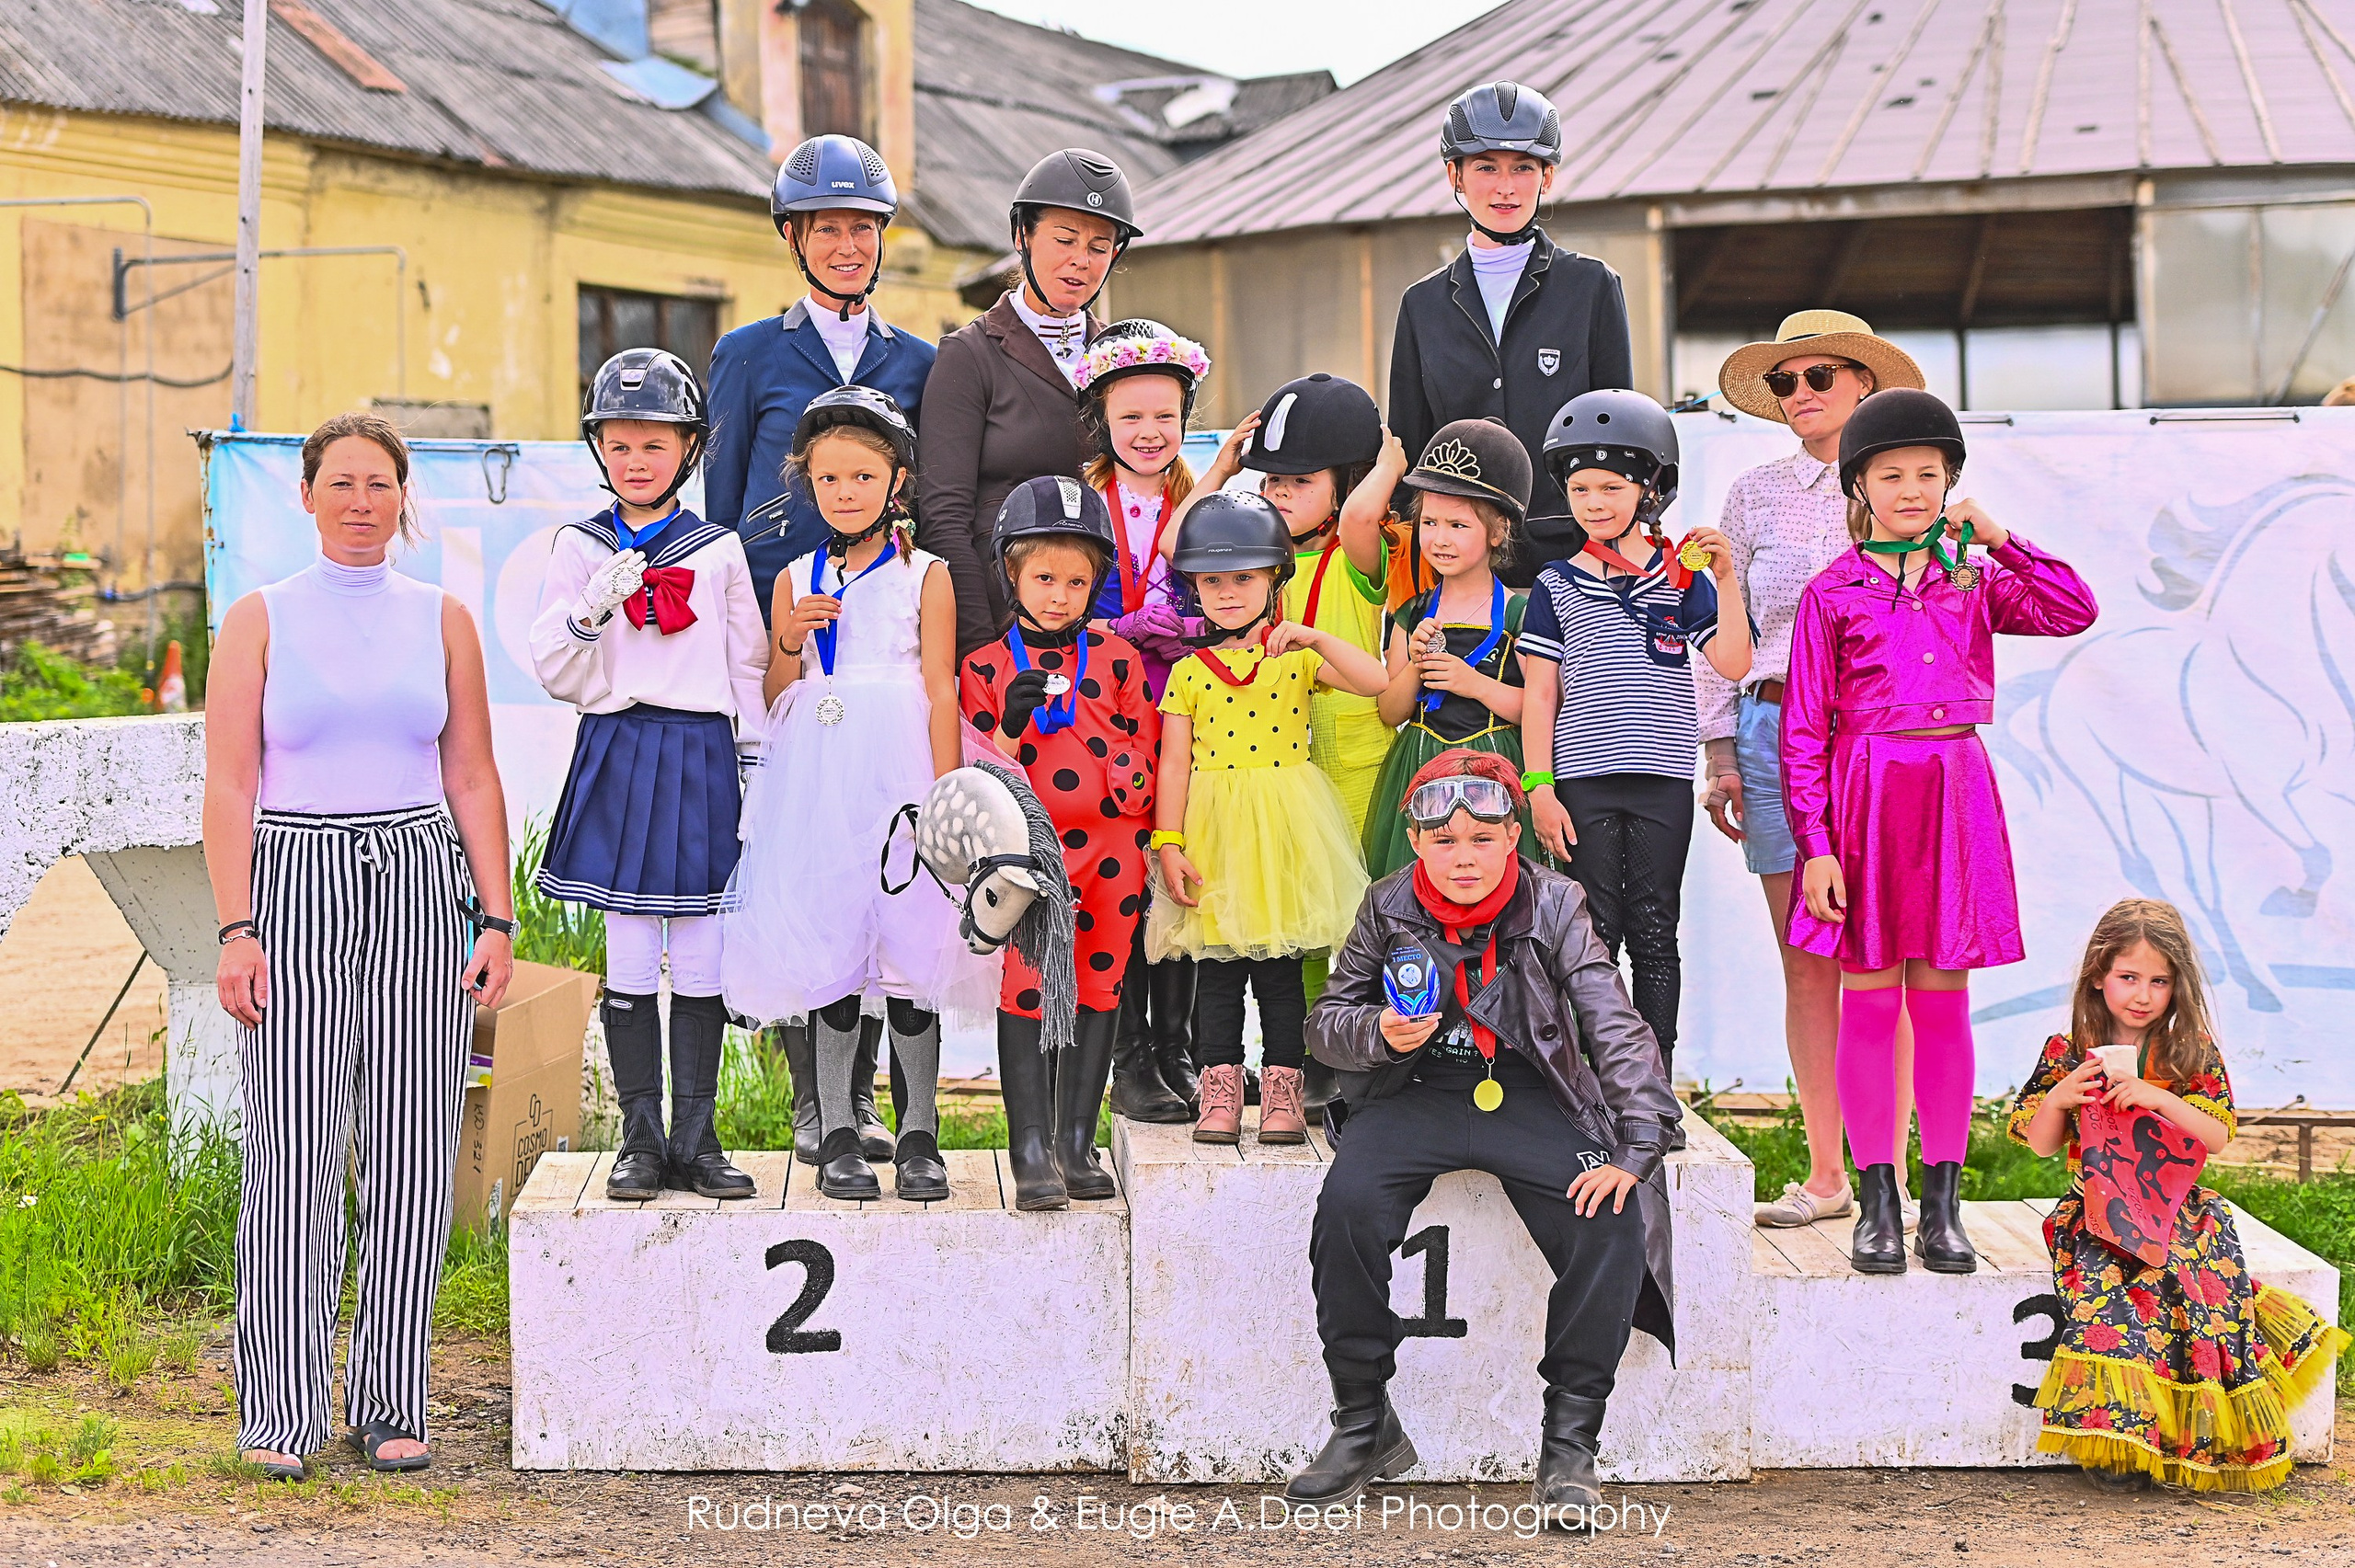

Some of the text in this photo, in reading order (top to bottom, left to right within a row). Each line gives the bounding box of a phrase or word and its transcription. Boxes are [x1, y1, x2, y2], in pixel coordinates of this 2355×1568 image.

[831, 181, 856, 189] uvex
[517, 1127, 548, 1159] COSMO
[764, 1239, 842, 1354] 2
[1399, 1224, 1468, 1339] 1
[2011, 1293, 2066, 1409] 3
